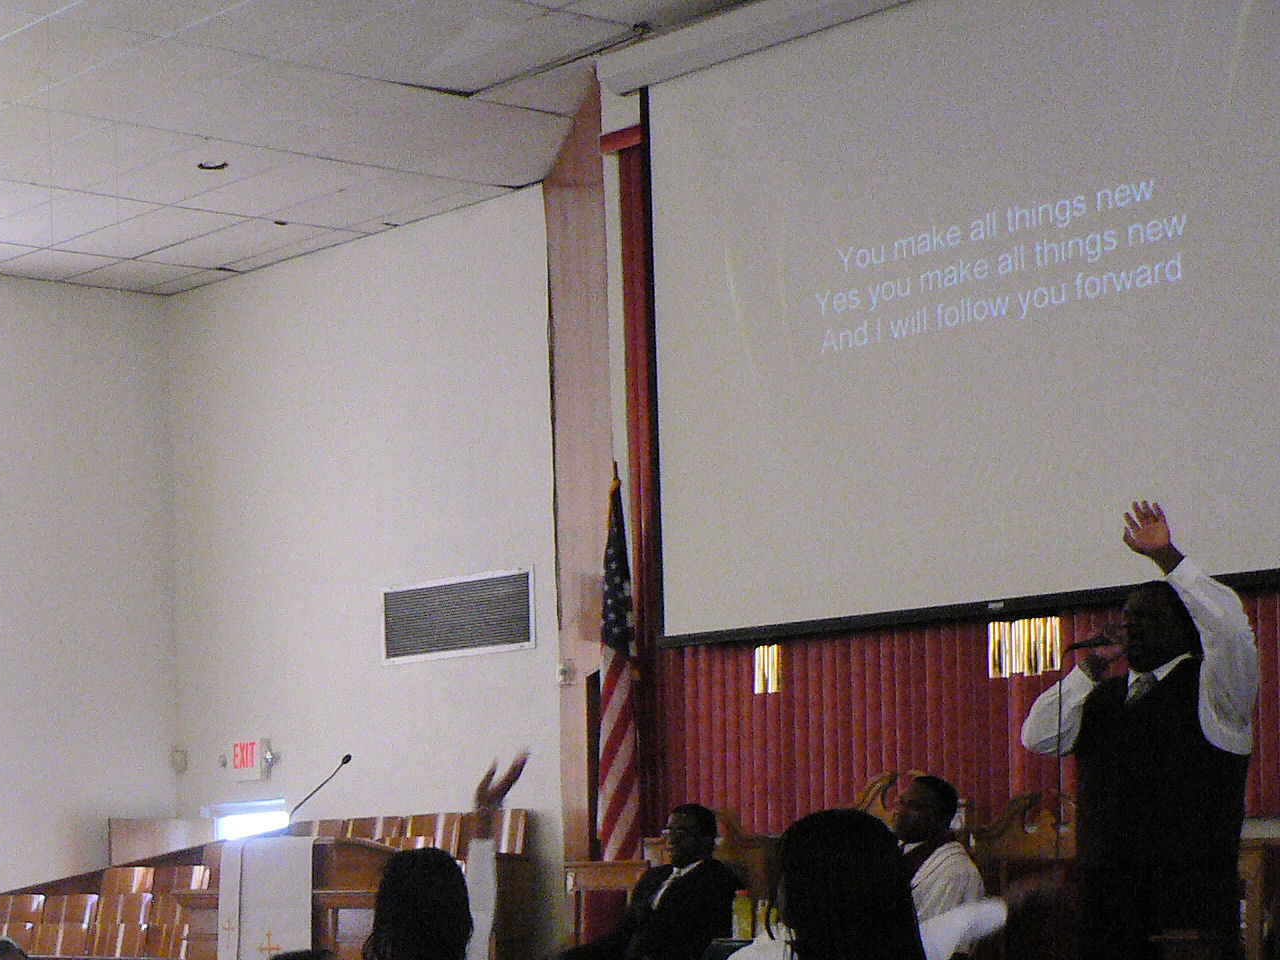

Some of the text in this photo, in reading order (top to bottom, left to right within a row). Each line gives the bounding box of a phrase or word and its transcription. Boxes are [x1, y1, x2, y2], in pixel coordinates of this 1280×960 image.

[815, 213, 1187, 316] Yes you make all things new
[837, 178, 1155, 273] You make all things new
[821, 319, 869, 354] And
[890, 307, 928, 339] will
[936, 295, 1010, 330] follow
[1018, 283, 1066, 320] you
[1075, 252, 1182, 300] forward
[233, 741, 256, 768] EXIT
